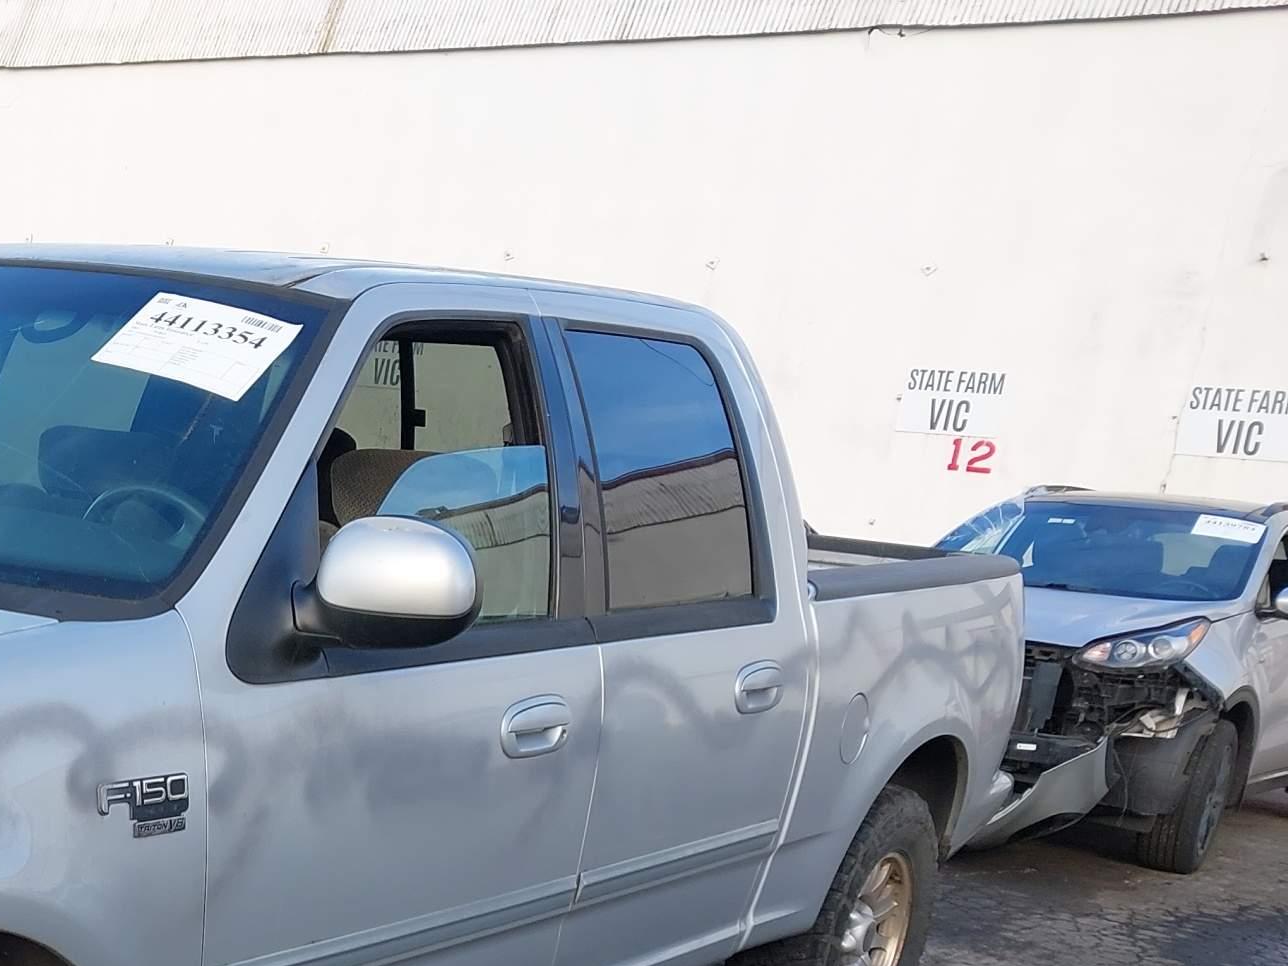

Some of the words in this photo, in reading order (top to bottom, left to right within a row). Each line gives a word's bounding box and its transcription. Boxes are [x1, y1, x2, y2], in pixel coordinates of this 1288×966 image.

[149, 311, 268, 349] 44113354
[908, 369, 955, 392] STATE
[955, 371, 1007, 395] FARM
[929, 398, 971, 432] VIC
[1189, 386, 1246, 412] STATE
[1247, 389, 1288, 415] FAR
[1216, 418, 1265, 456] VIC
[947, 438, 996, 474] 12
